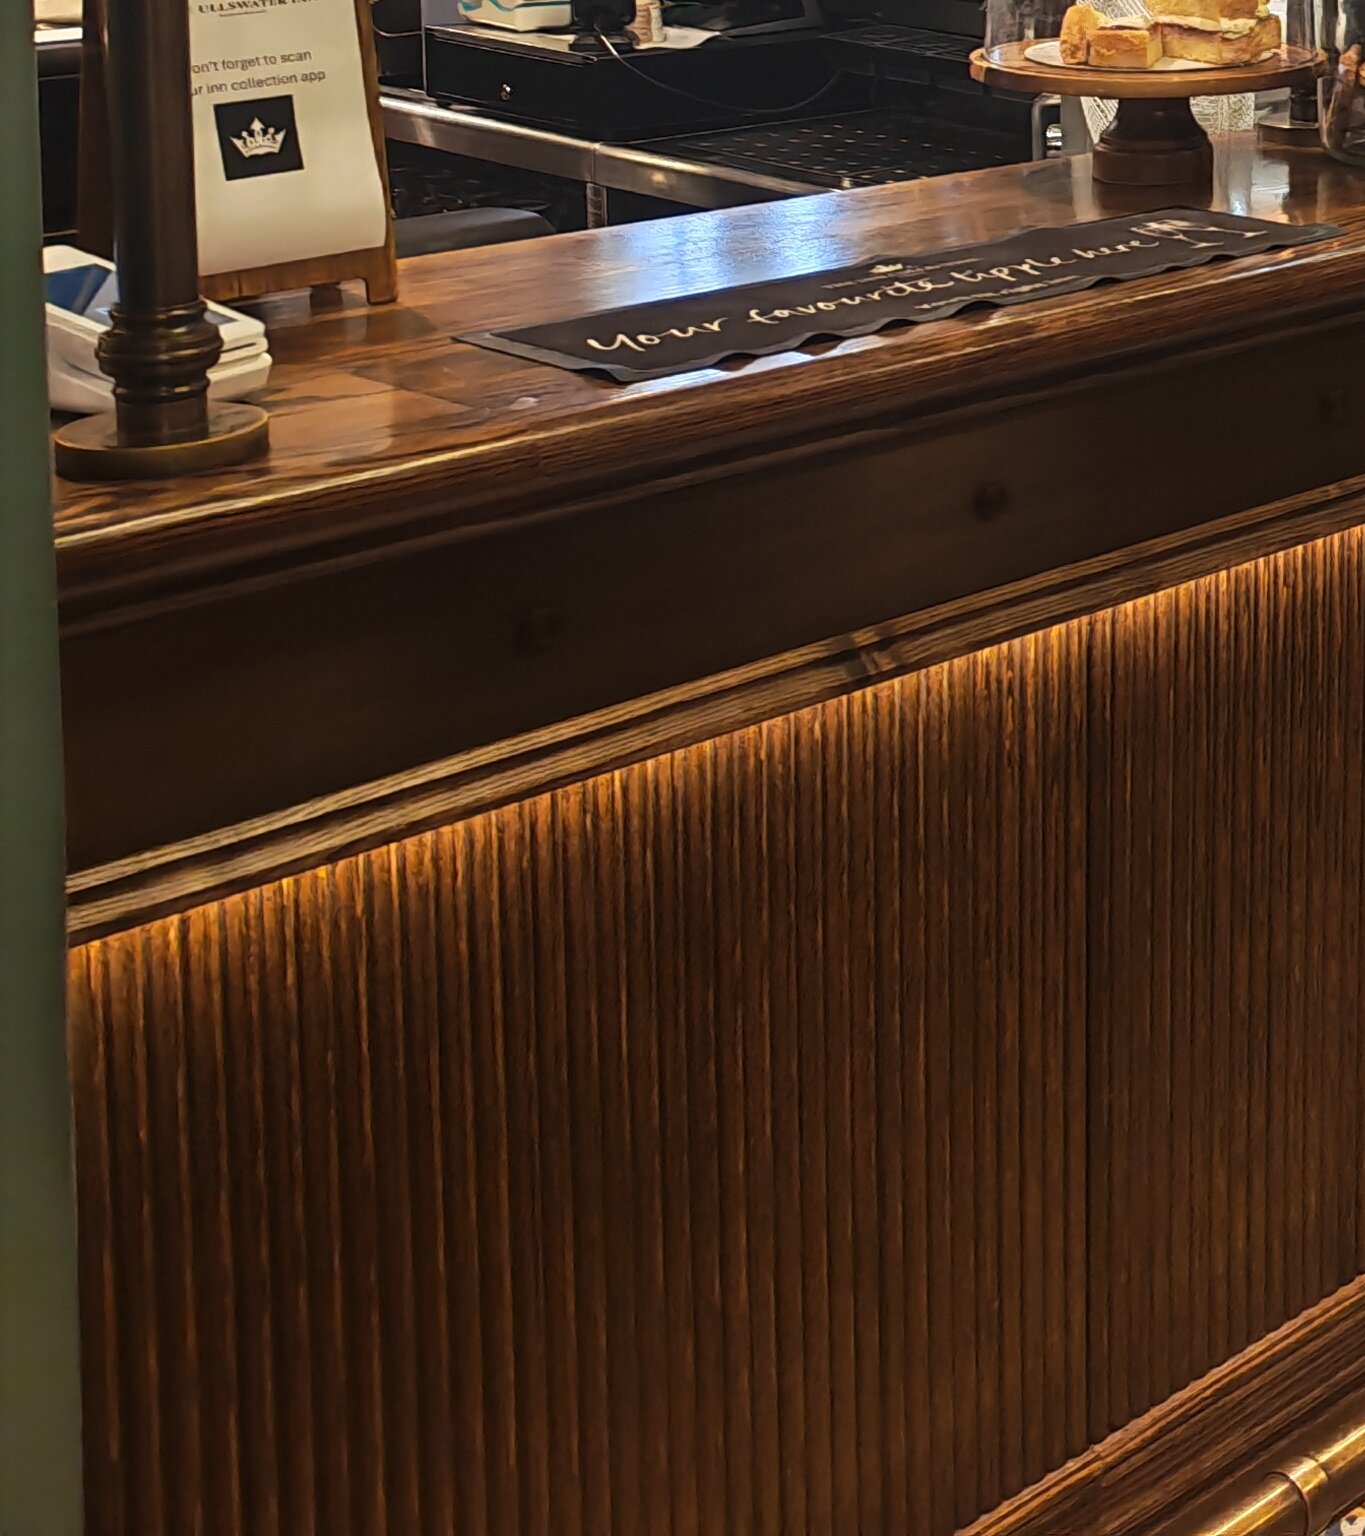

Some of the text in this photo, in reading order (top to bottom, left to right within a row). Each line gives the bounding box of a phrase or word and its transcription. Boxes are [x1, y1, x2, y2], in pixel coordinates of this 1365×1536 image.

[191, 50, 313, 74] on't forget to scan
[206, 83, 228, 95] inn
[230, 73, 298, 91] collection
[300, 70, 326, 83] app
[586, 317, 729, 352] Your
[747, 278, 955, 325] favourite
[949, 256, 1077, 283] tipple
[1072, 238, 1160, 260] here
